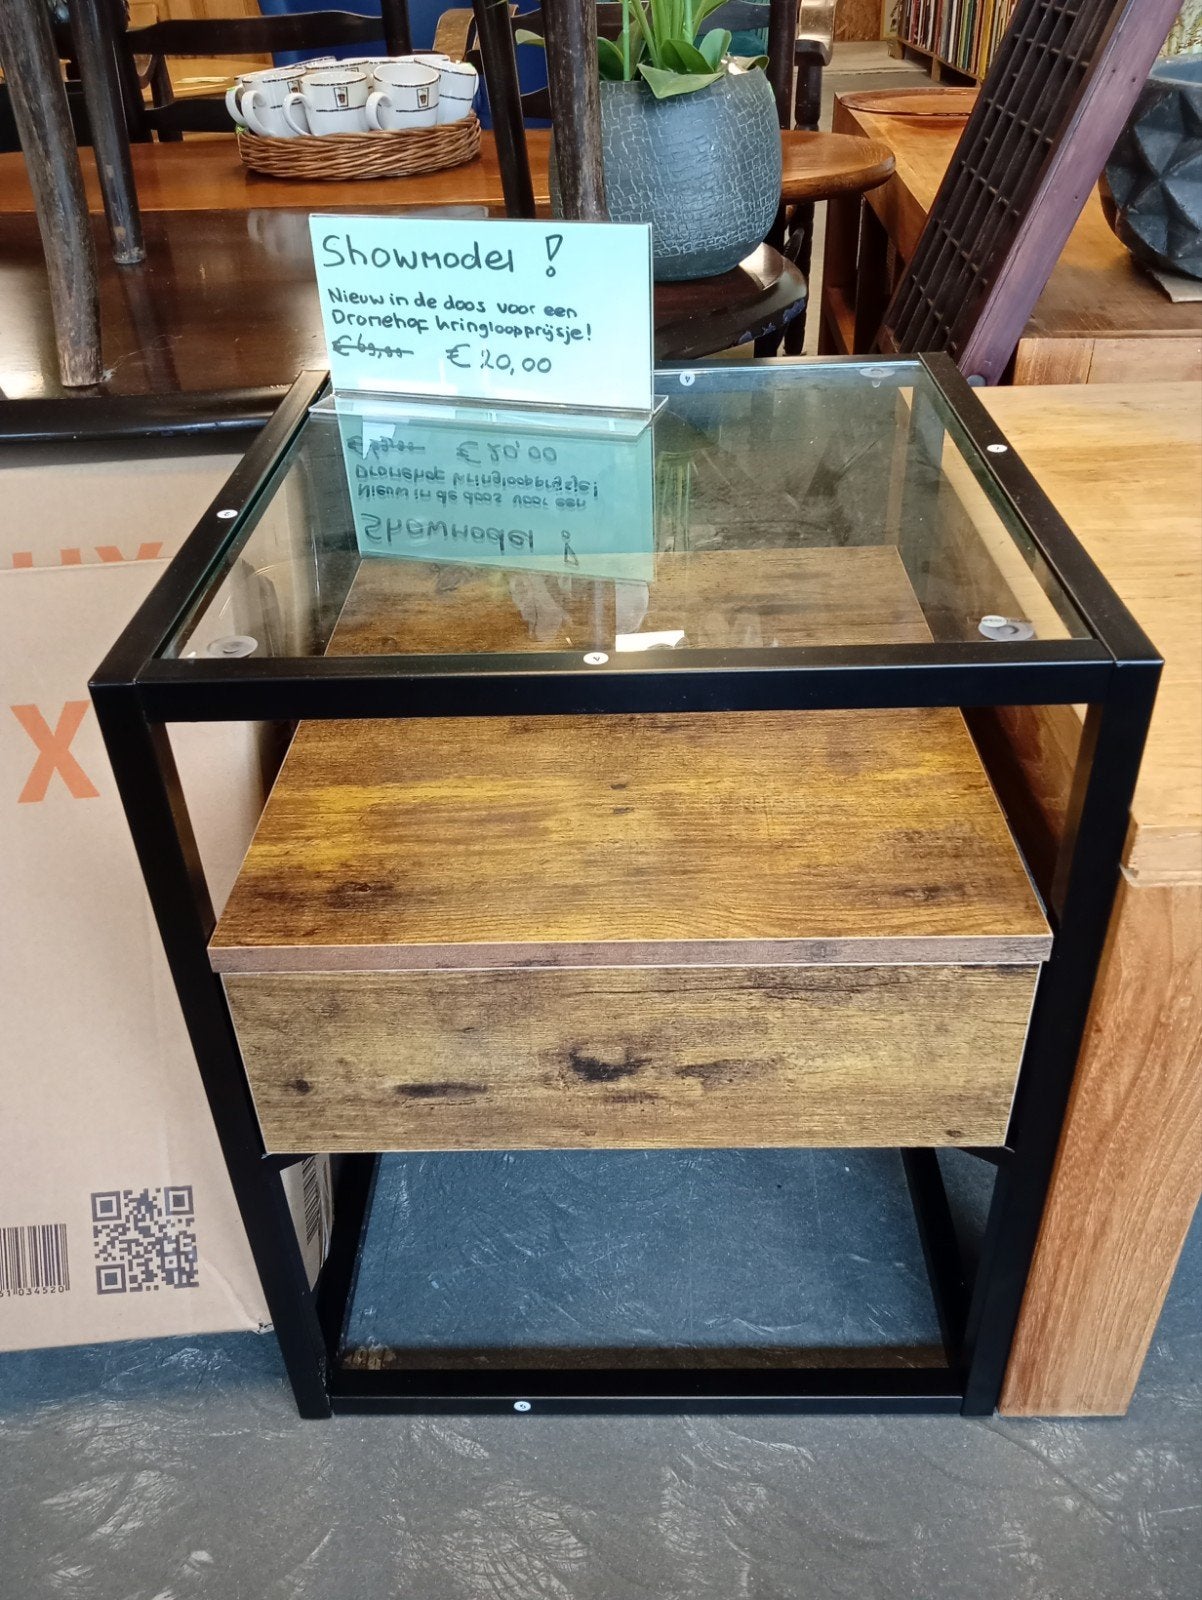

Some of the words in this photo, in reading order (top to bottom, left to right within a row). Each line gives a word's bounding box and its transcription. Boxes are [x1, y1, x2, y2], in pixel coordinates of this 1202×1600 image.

[545, 234, 563, 277] !
[328, 287, 385, 305] Nieuw
[389, 292, 409, 307] in
[414, 292, 437, 309] de
[443, 295, 486, 312] doos
[497, 302, 536, 316] voor
[544, 304, 577, 318] een
